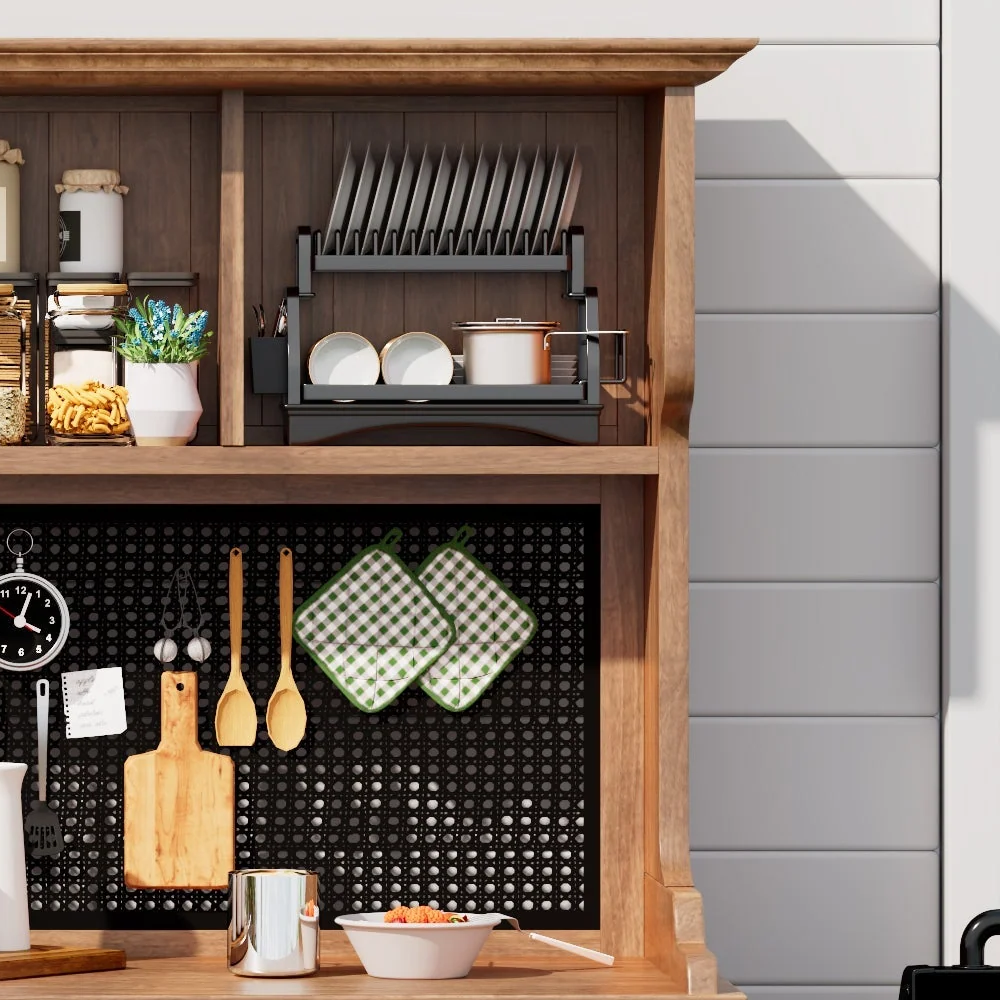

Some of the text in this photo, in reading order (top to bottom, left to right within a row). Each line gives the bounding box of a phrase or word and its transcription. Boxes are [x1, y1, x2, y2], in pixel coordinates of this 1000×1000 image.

[0, 589, 10, 598] 11
[15, 586, 27, 595] 12
[35, 589, 41, 599] 1
[44, 598, 51, 608] 2
[49, 616, 56, 625] 3
[45, 633, 53, 642] 4
[0, 644, 8, 654] 7
[17, 647, 25, 657] 6
[35, 644, 42, 654] 5
